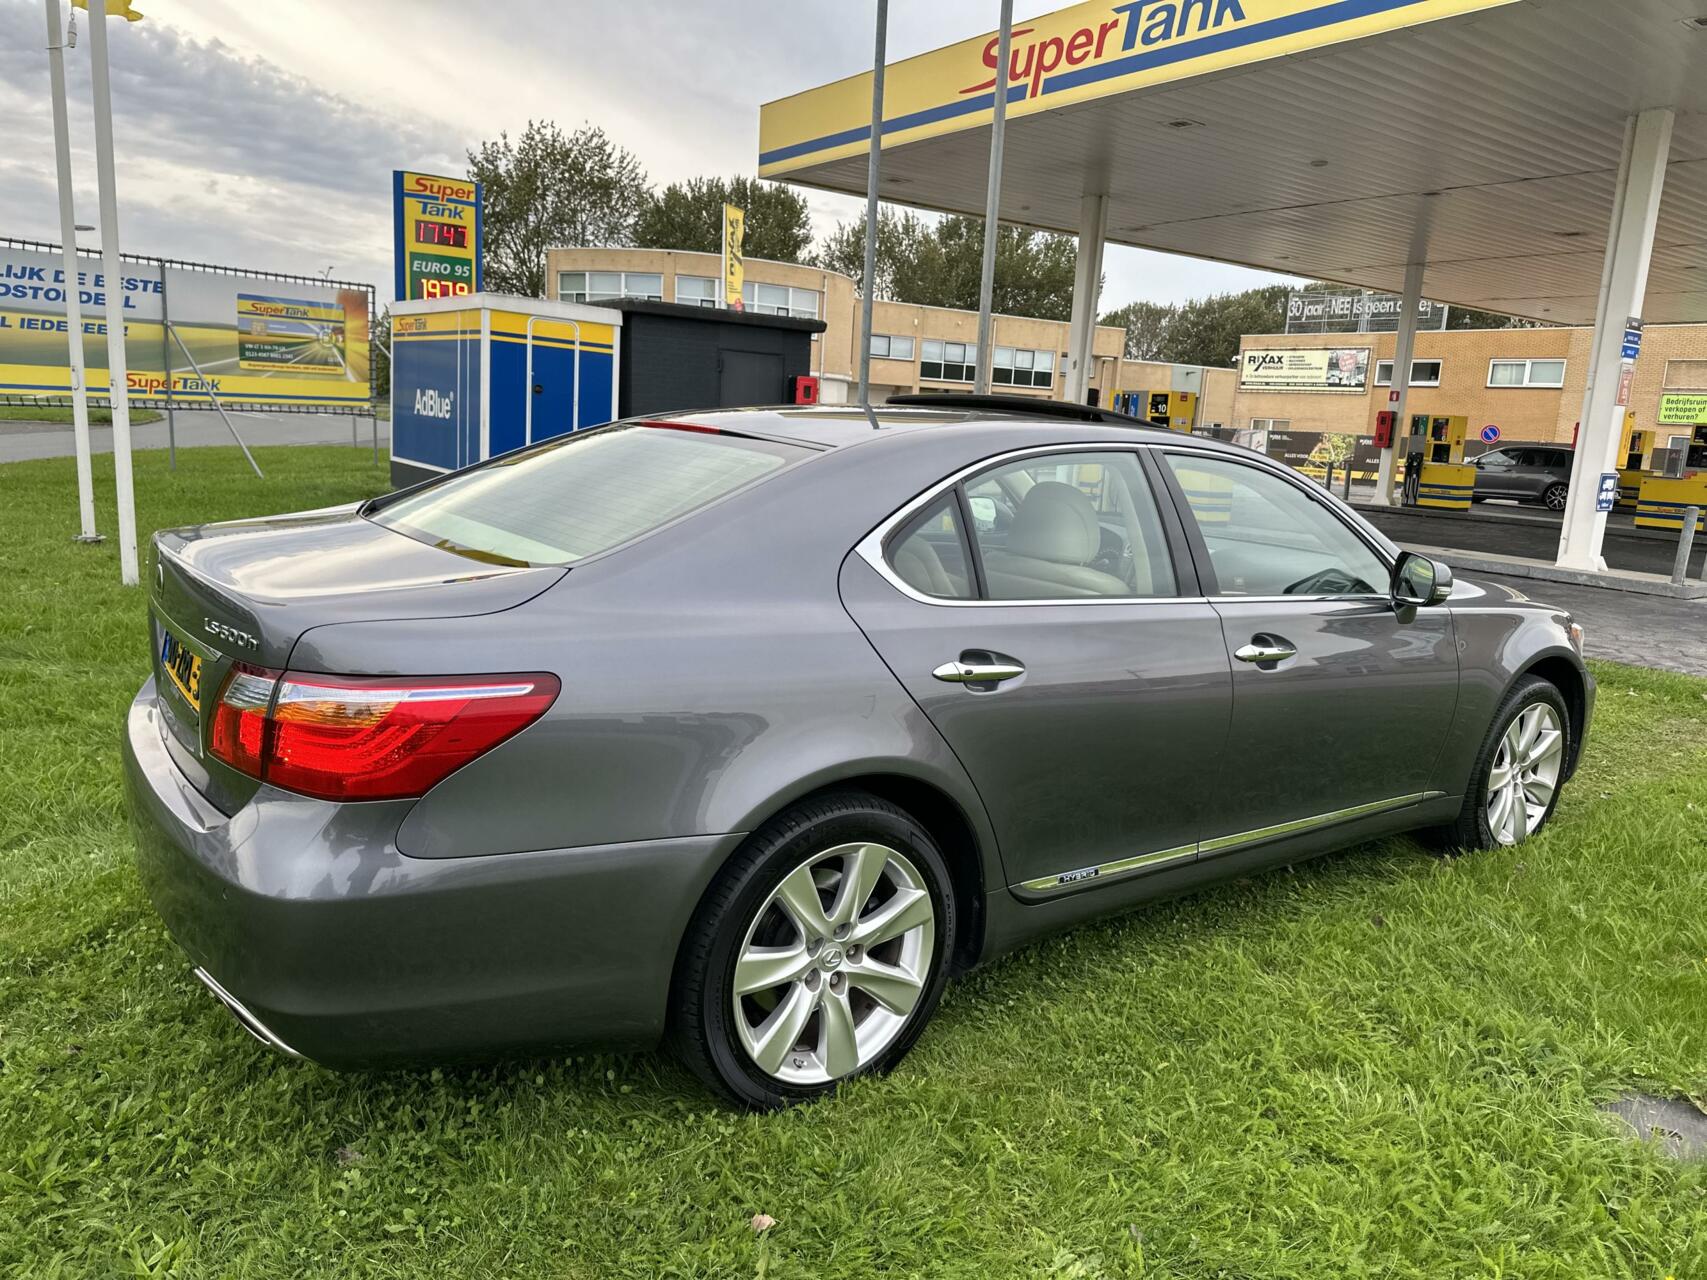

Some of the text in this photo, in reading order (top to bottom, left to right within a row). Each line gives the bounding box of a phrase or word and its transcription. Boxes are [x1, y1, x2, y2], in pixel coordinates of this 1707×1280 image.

[404, 177, 474, 202] Super
[416, 200, 464, 220] Tank
[419, 223, 468, 247] 1747
[412, 260, 471, 277] EURO 95
[94, 274, 163, 294] BSTE
[250, 302, 309, 317] SuperTank
[1288, 302, 1301, 316] 30
[1302, 301, 1324, 321] jaar
[1331, 298, 1350, 314] NEE
[1365, 301, 1394, 318] geen
[20, 317, 128, 337] IEDEEE!
[414, 388, 452, 419] AdBlue
[1158, 404, 1167, 412] 10
[1063, 871, 1096, 883] HYBRID
